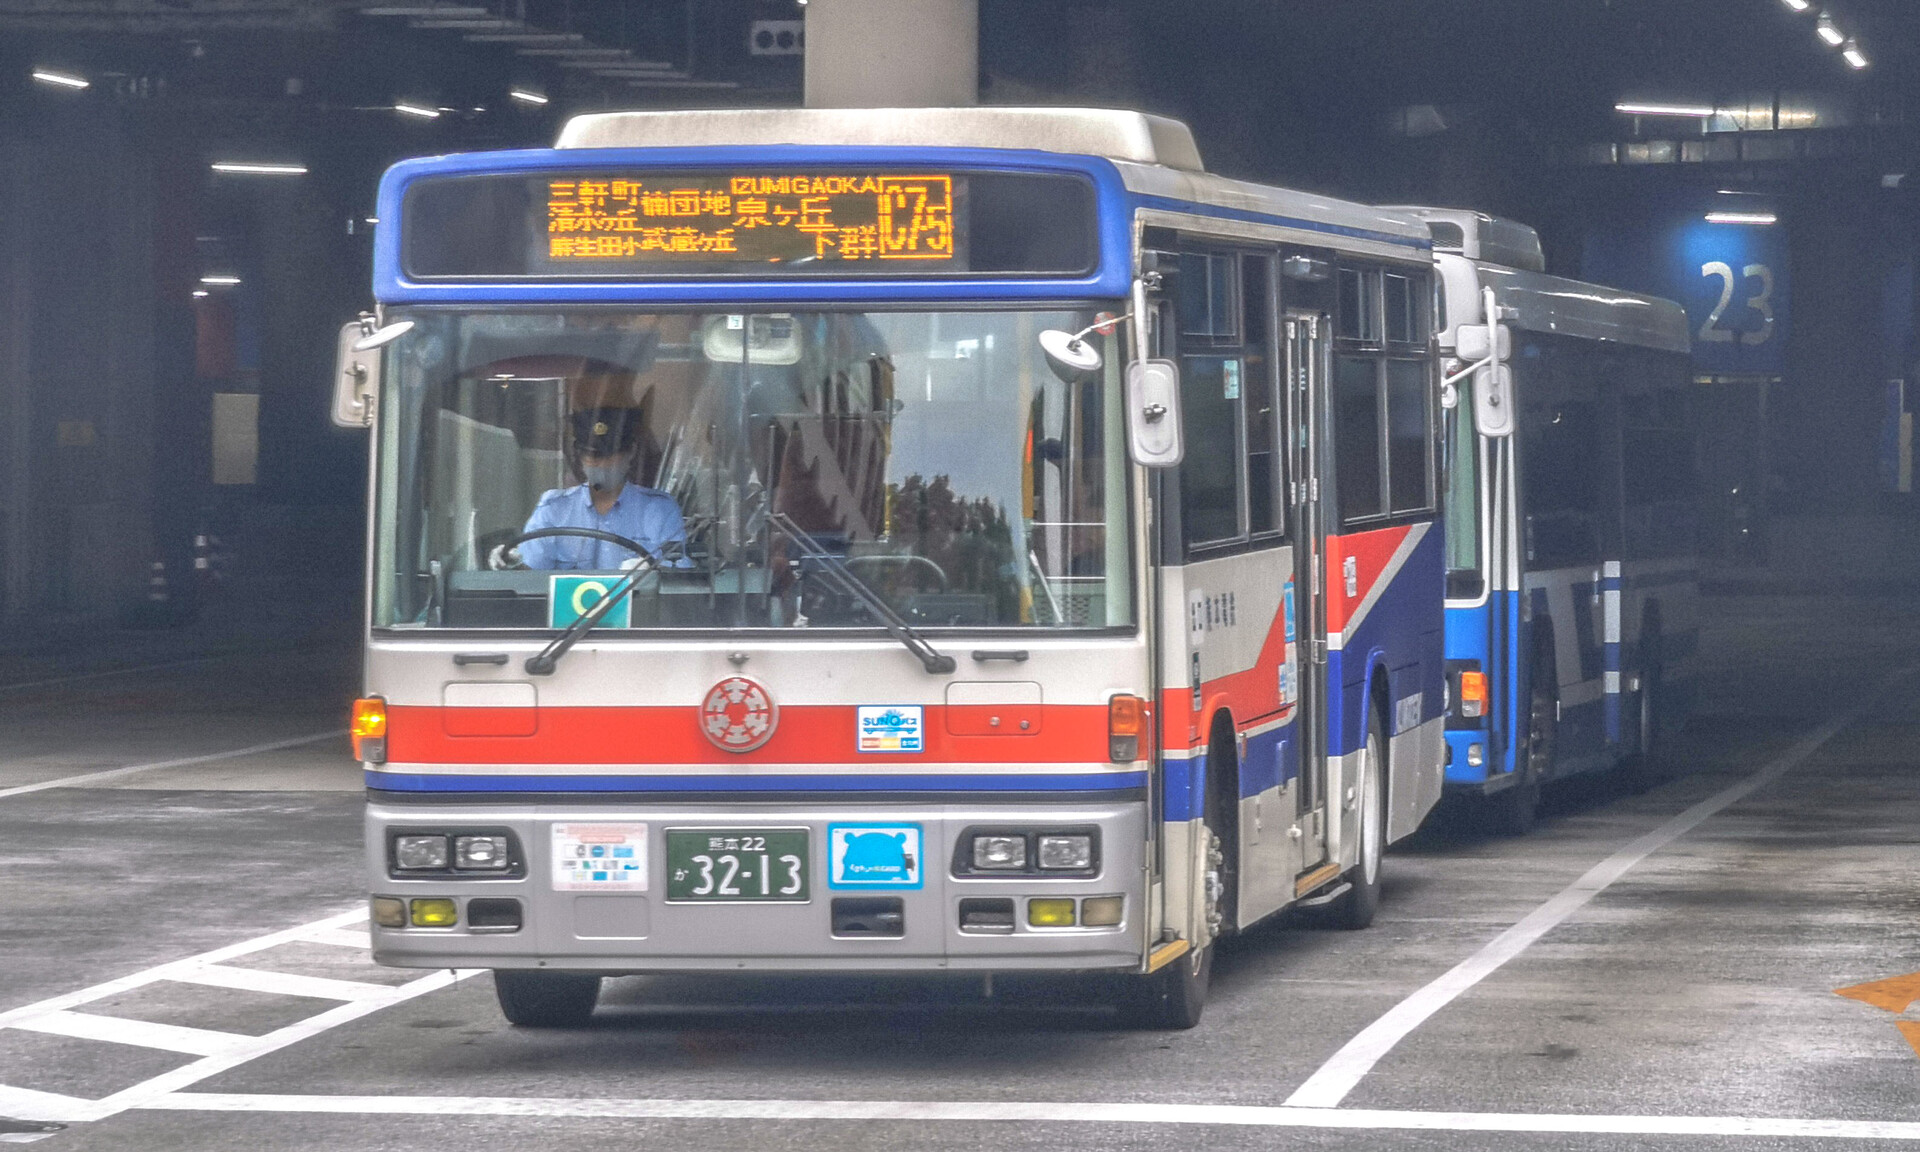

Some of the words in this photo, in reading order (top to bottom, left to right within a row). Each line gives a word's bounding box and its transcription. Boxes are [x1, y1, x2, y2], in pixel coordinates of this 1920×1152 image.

[548, 181, 642, 207] 三軒町
[731, 176, 878, 195] IZUMIGAOKA
[1699, 260, 1774, 346] 23
[691, 854, 802, 895] 32-13
